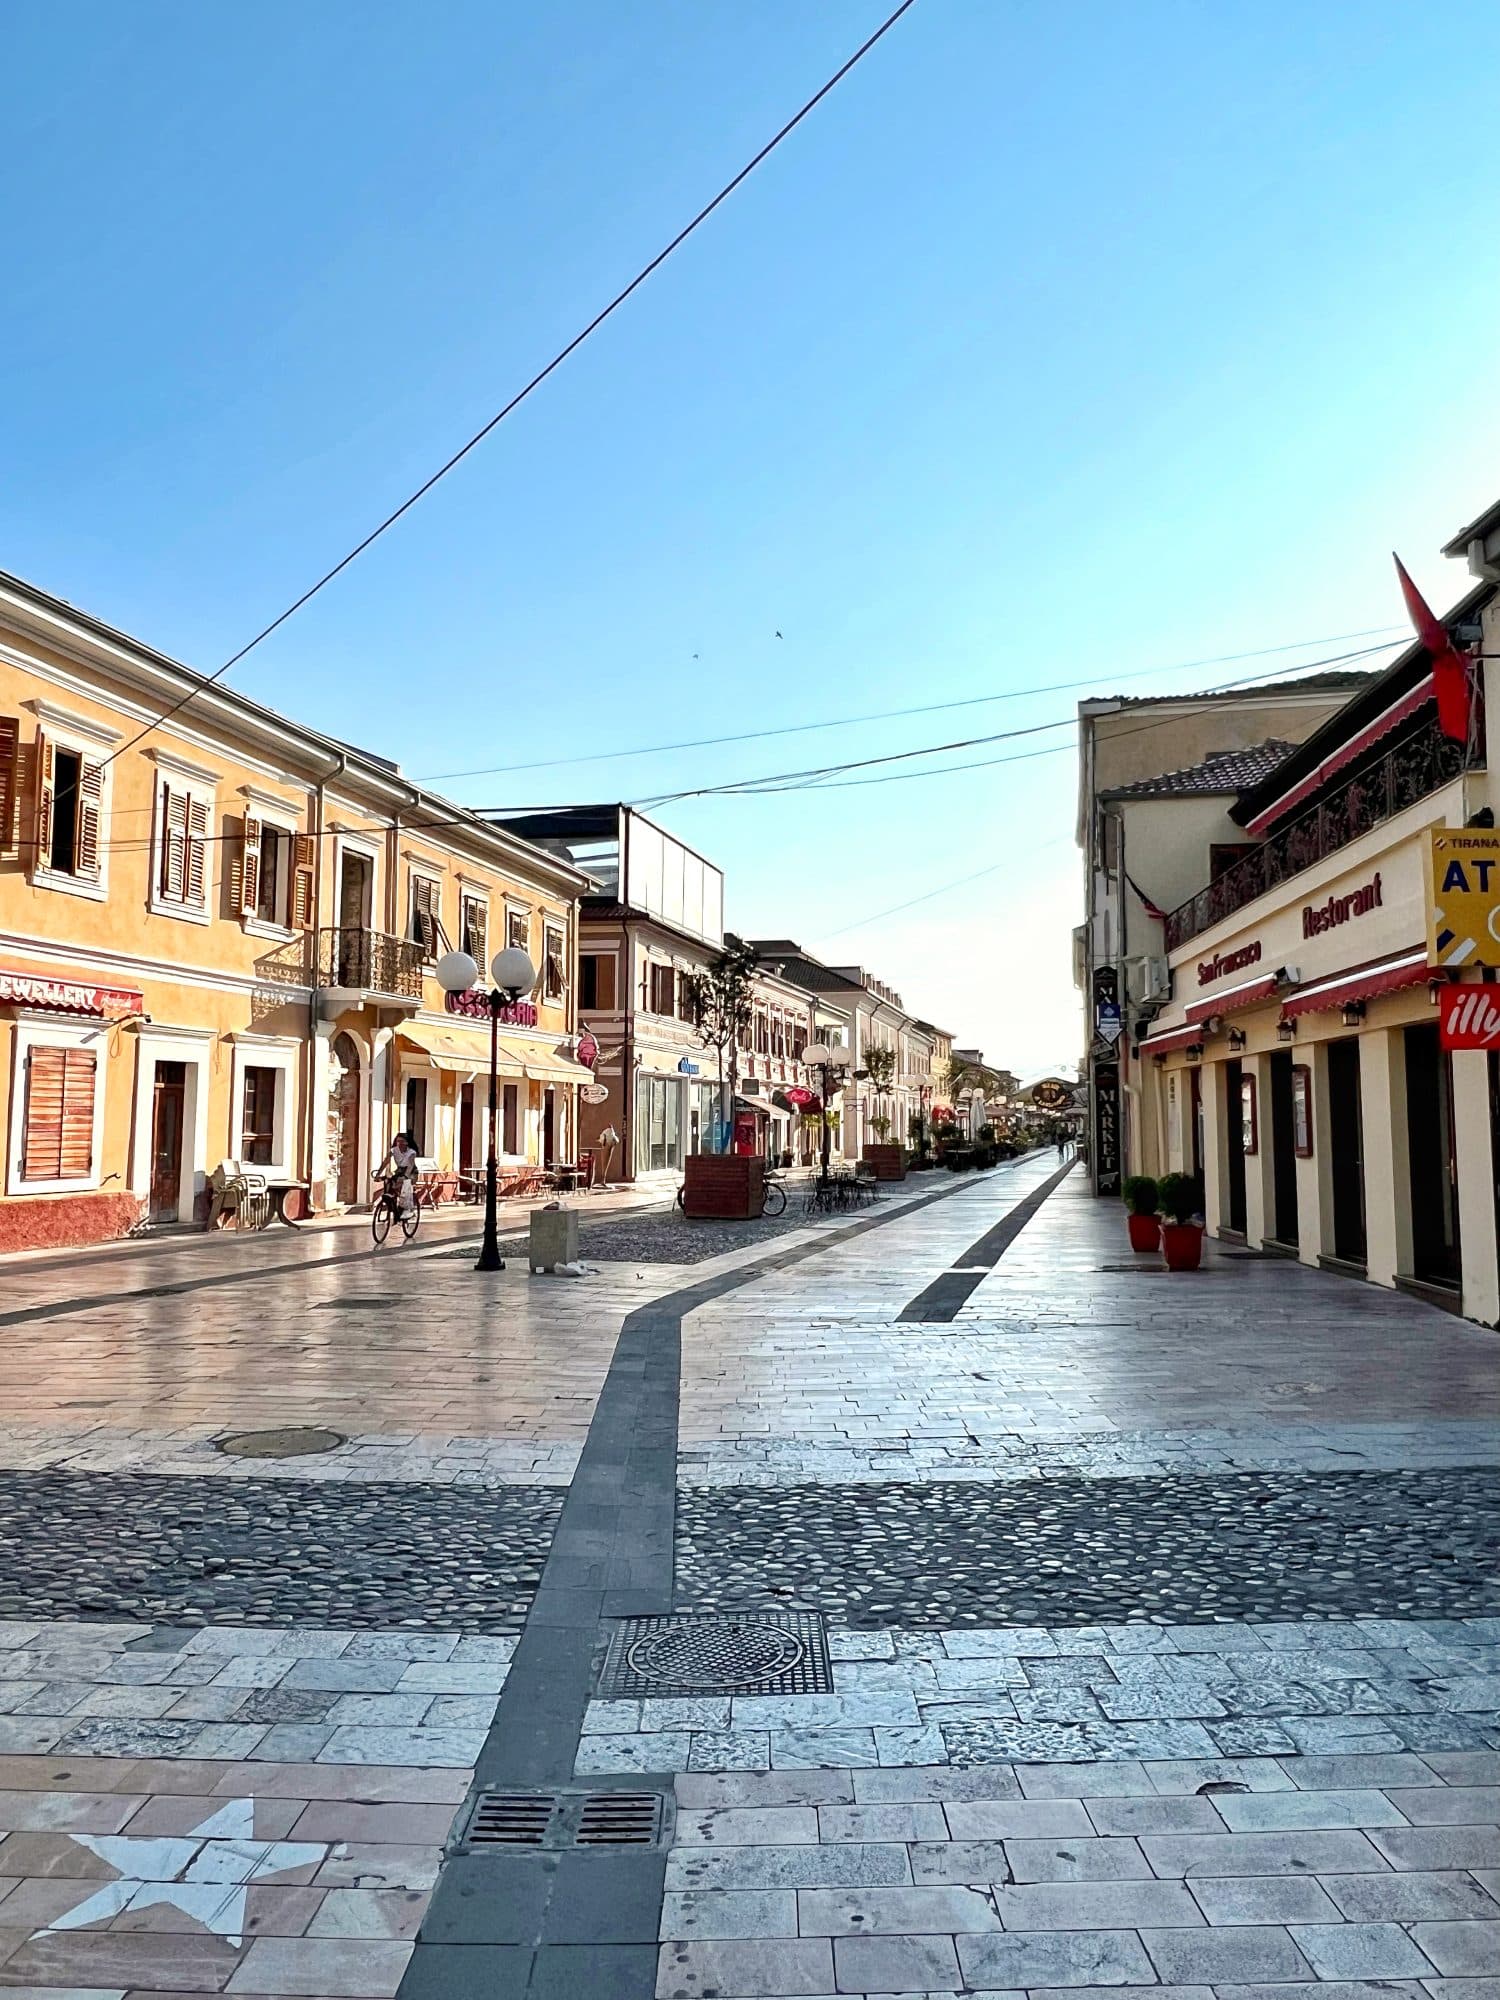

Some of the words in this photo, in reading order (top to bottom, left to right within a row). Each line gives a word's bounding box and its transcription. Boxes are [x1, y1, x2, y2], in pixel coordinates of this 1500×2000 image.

[1449, 838, 1500, 849] TIRANA
[1302, 872, 1382, 940] Restorant
[1446, 992, 1500, 1045] illy
[1099, 1089, 1116, 1169] MARKET
